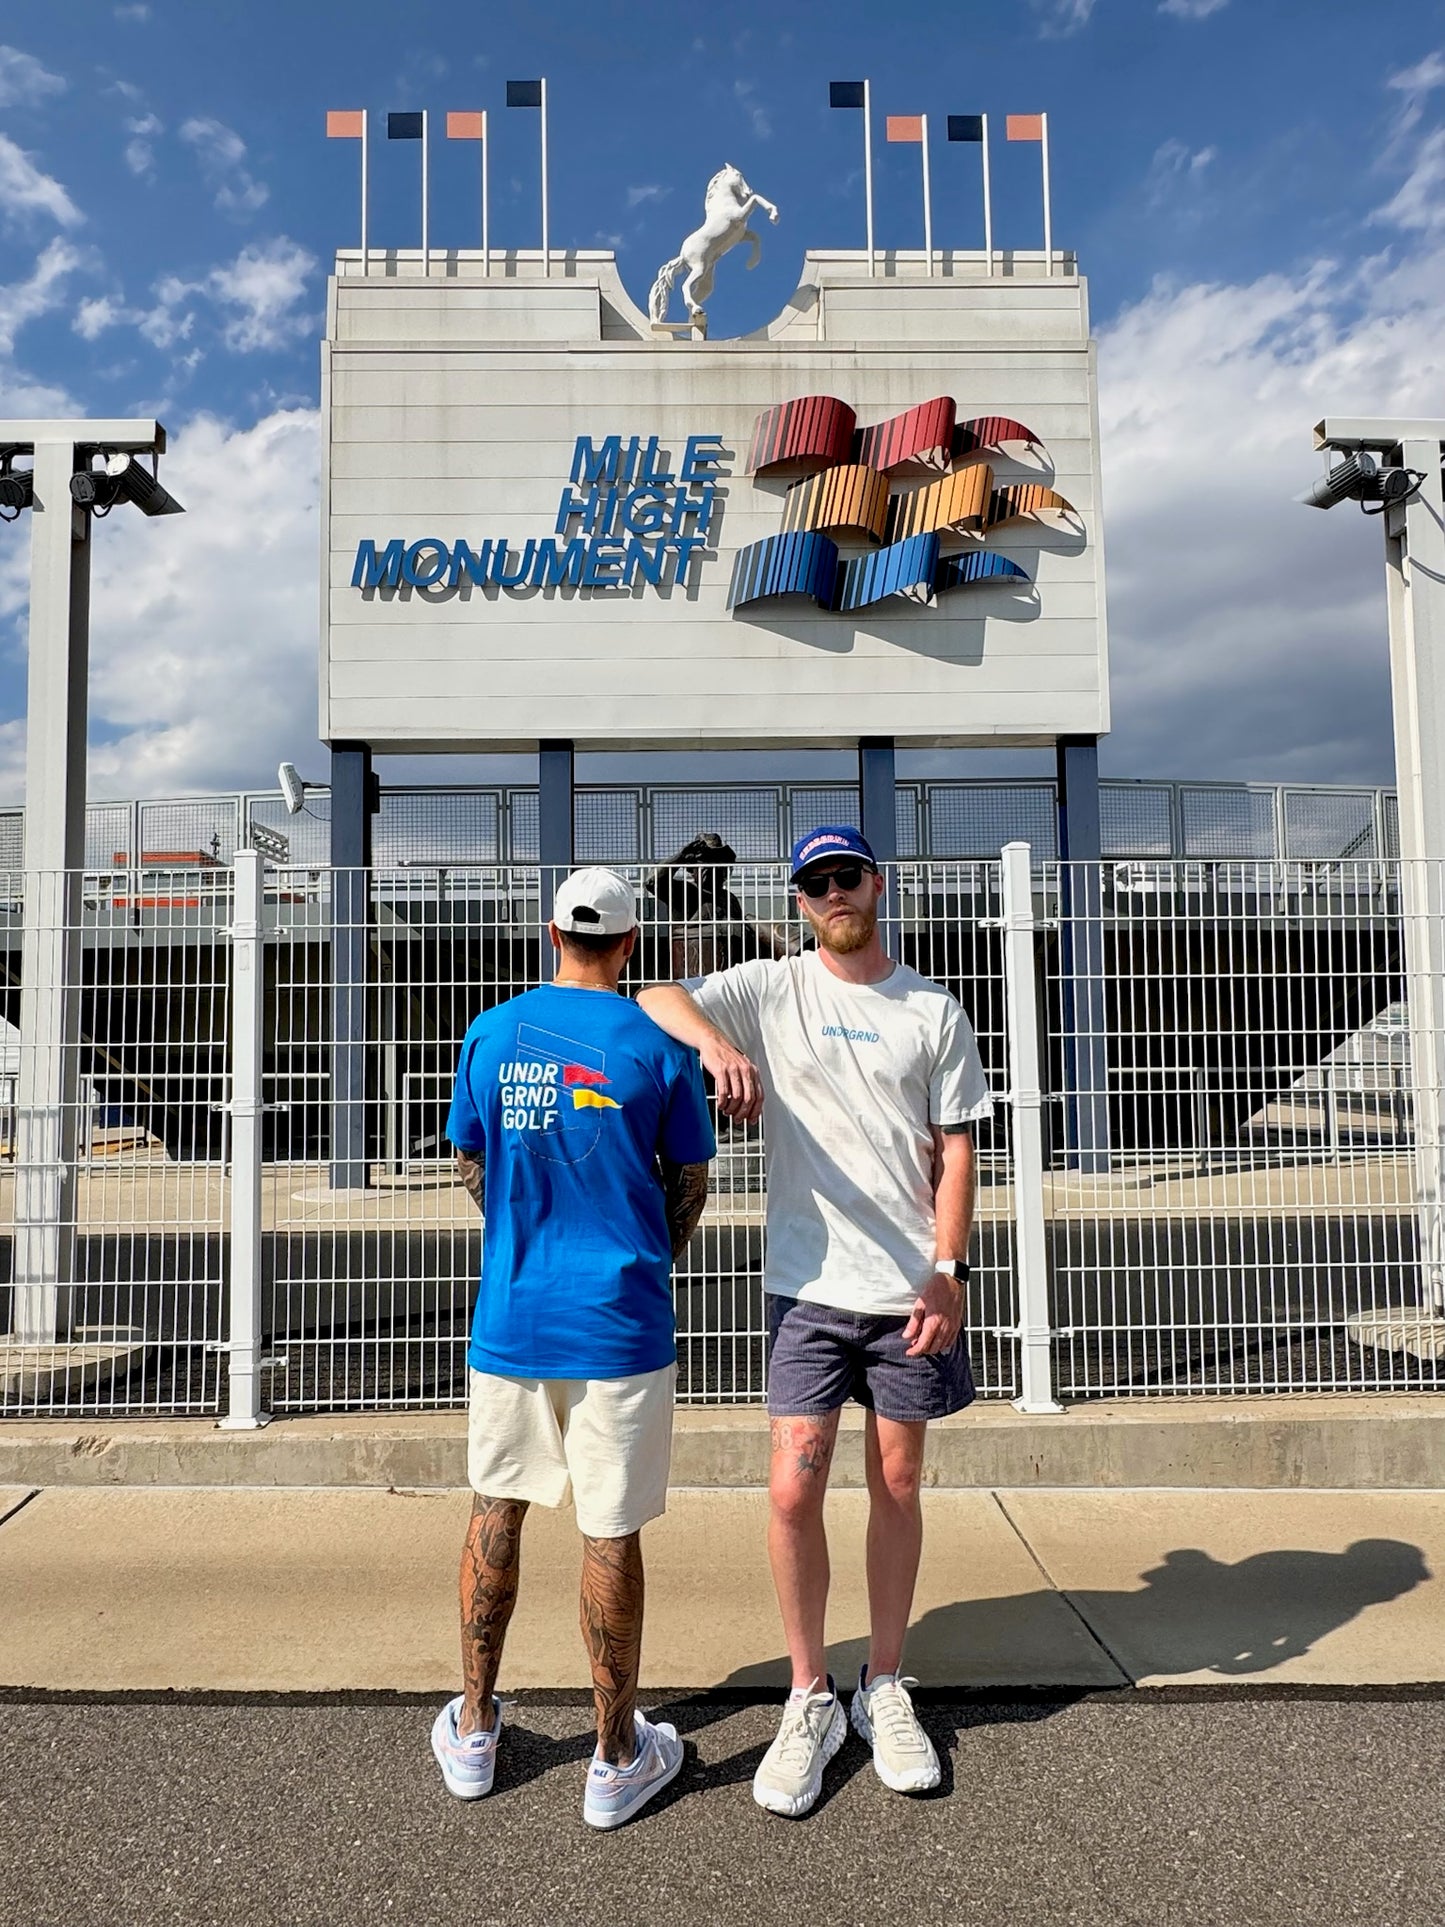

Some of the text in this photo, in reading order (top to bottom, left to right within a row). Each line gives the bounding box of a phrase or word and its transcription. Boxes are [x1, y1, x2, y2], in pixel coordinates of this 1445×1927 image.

[569, 435, 722, 483] MILE
[555, 486, 715, 535] HIGH
[351, 537, 705, 587] MONUMENT
[821, 1025, 880, 1043] UNDRGRND
[498, 1062, 559, 1084] UNDR
[501, 1085, 558, 1107] GRND
[503, 1108, 558, 1130] GOLF
